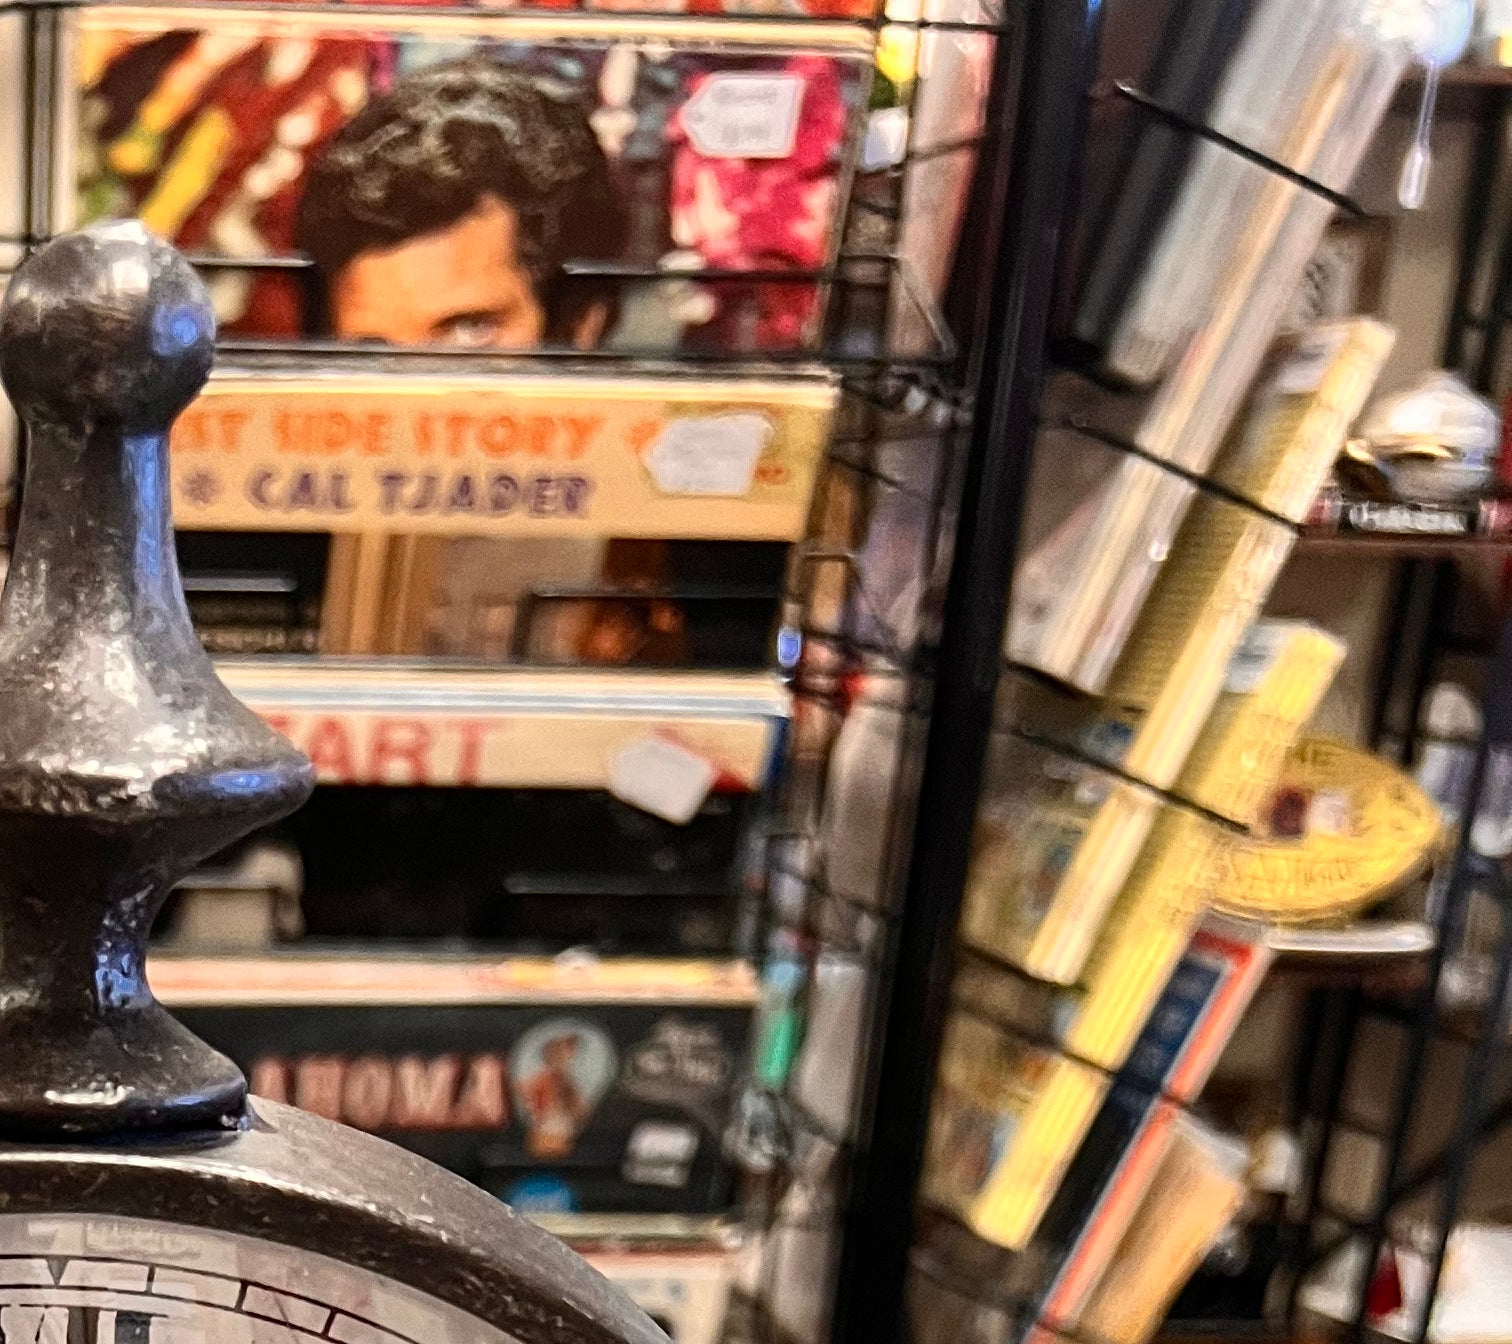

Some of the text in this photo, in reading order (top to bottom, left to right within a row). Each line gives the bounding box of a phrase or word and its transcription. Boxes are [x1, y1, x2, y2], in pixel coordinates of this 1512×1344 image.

[272, 410, 389, 456] SIDE
[414, 411, 601, 458] STORY
[246, 466, 594, 518] CAL TJADER
